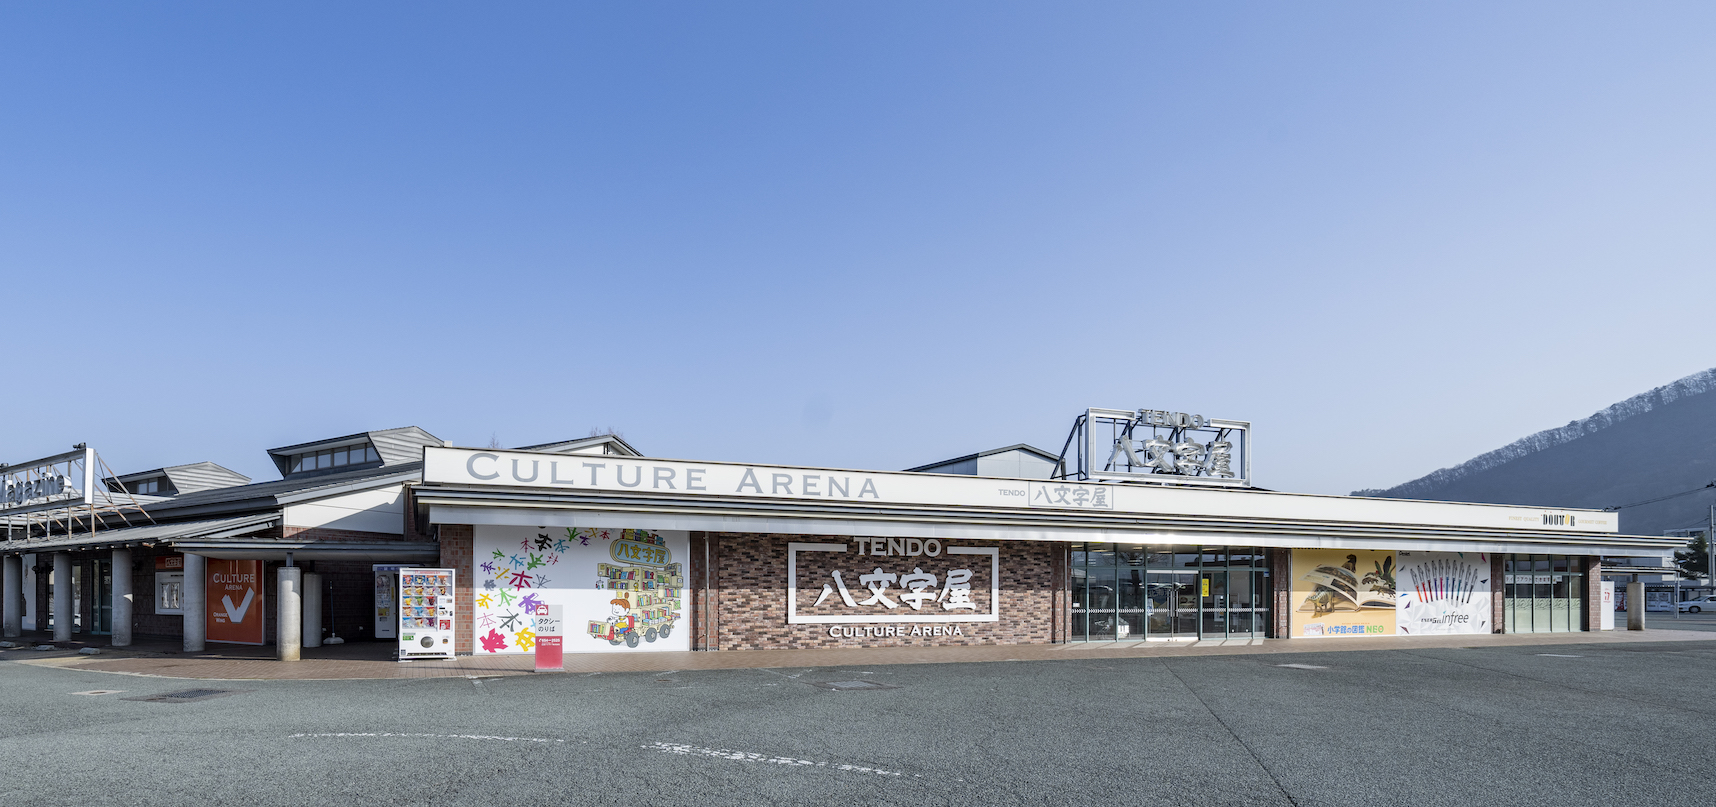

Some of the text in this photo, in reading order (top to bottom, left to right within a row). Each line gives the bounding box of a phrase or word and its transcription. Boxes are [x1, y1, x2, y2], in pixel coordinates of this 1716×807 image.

[1138, 408, 1204, 429] TENDO
[1108, 434, 1235, 478] 八文字屋
[466, 453, 880, 499] CULTURE ARENA
[0, 472, 72, 505] agazine
[998, 488, 1026, 497] TENDO
[1034, 485, 1108, 508] 八文字屋
[1543, 513, 1575, 526] DOUTOR
[617, 543, 667, 564] 八文字屋
[853, 536, 942, 557] TENDO
[212, 573, 255, 583] CULTURE
[813, 567, 977, 611] 八文字屋
[1441, 610, 1469, 626] infree
[829, 625, 963, 638] CULTURE ARENA
[1327, 625, 1384, 635] 小学館の図鑑 NEO
